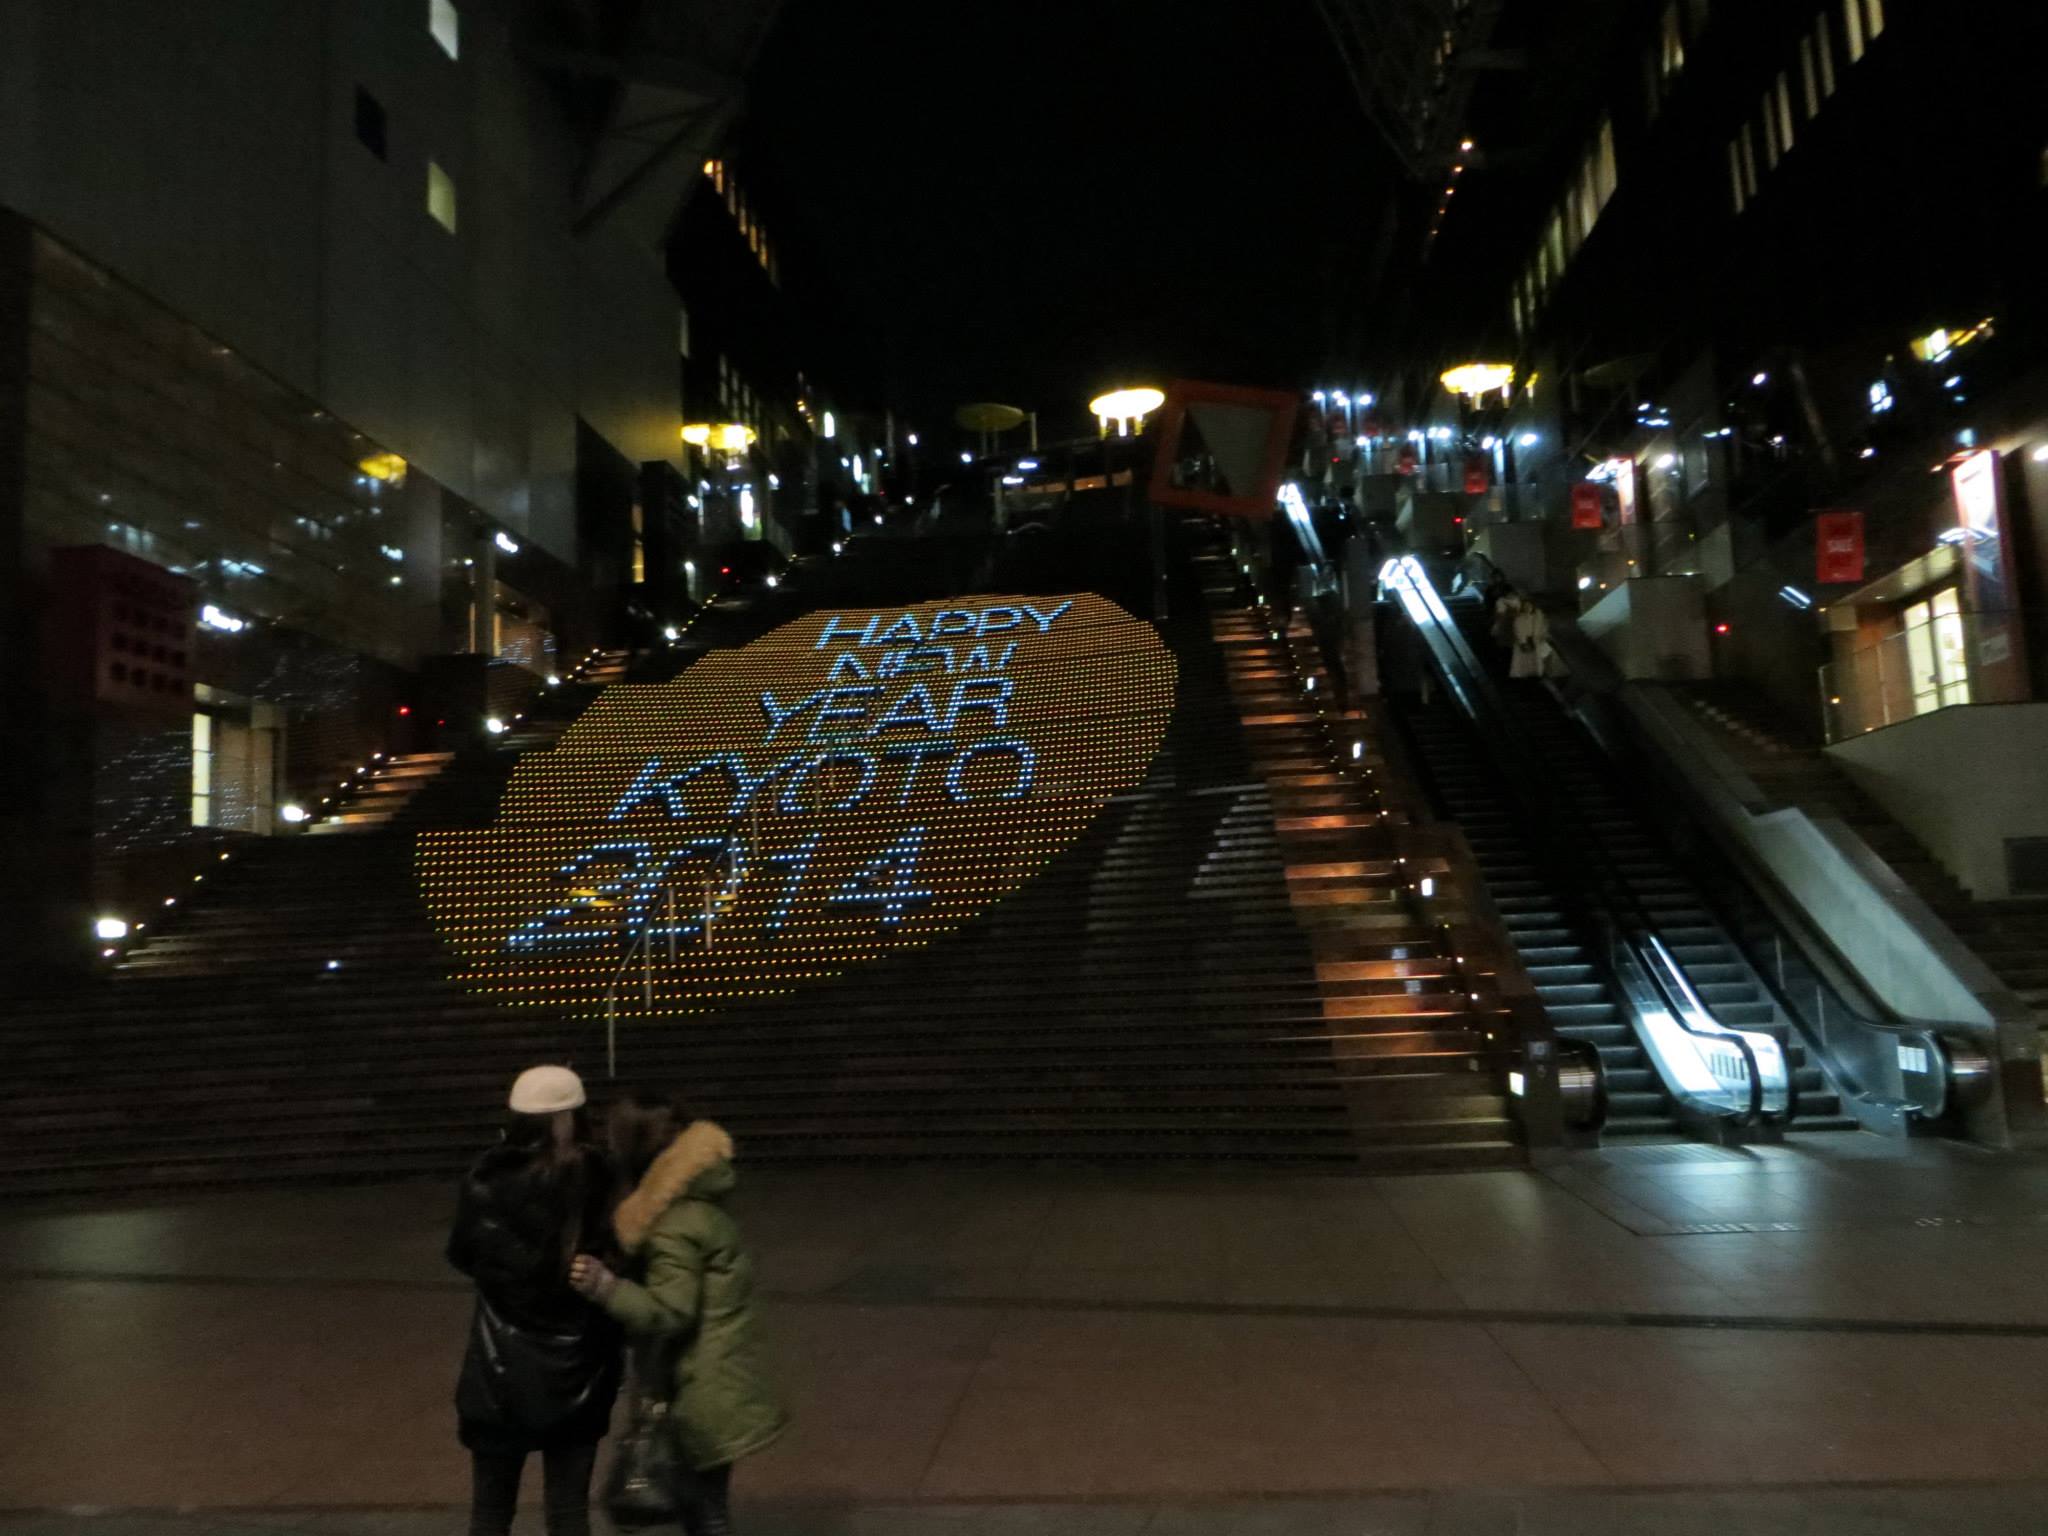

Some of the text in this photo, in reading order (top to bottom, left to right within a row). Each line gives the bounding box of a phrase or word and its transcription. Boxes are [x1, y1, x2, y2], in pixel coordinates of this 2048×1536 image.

[815, 601, 1072, 649] HAPPY
[827, 641, 1020, 681] NEW
[762, 677, 1014, 745] YEAR
[607, 735, 1037, 820] KYOTO
[508, 826, 932, 946] 2014
